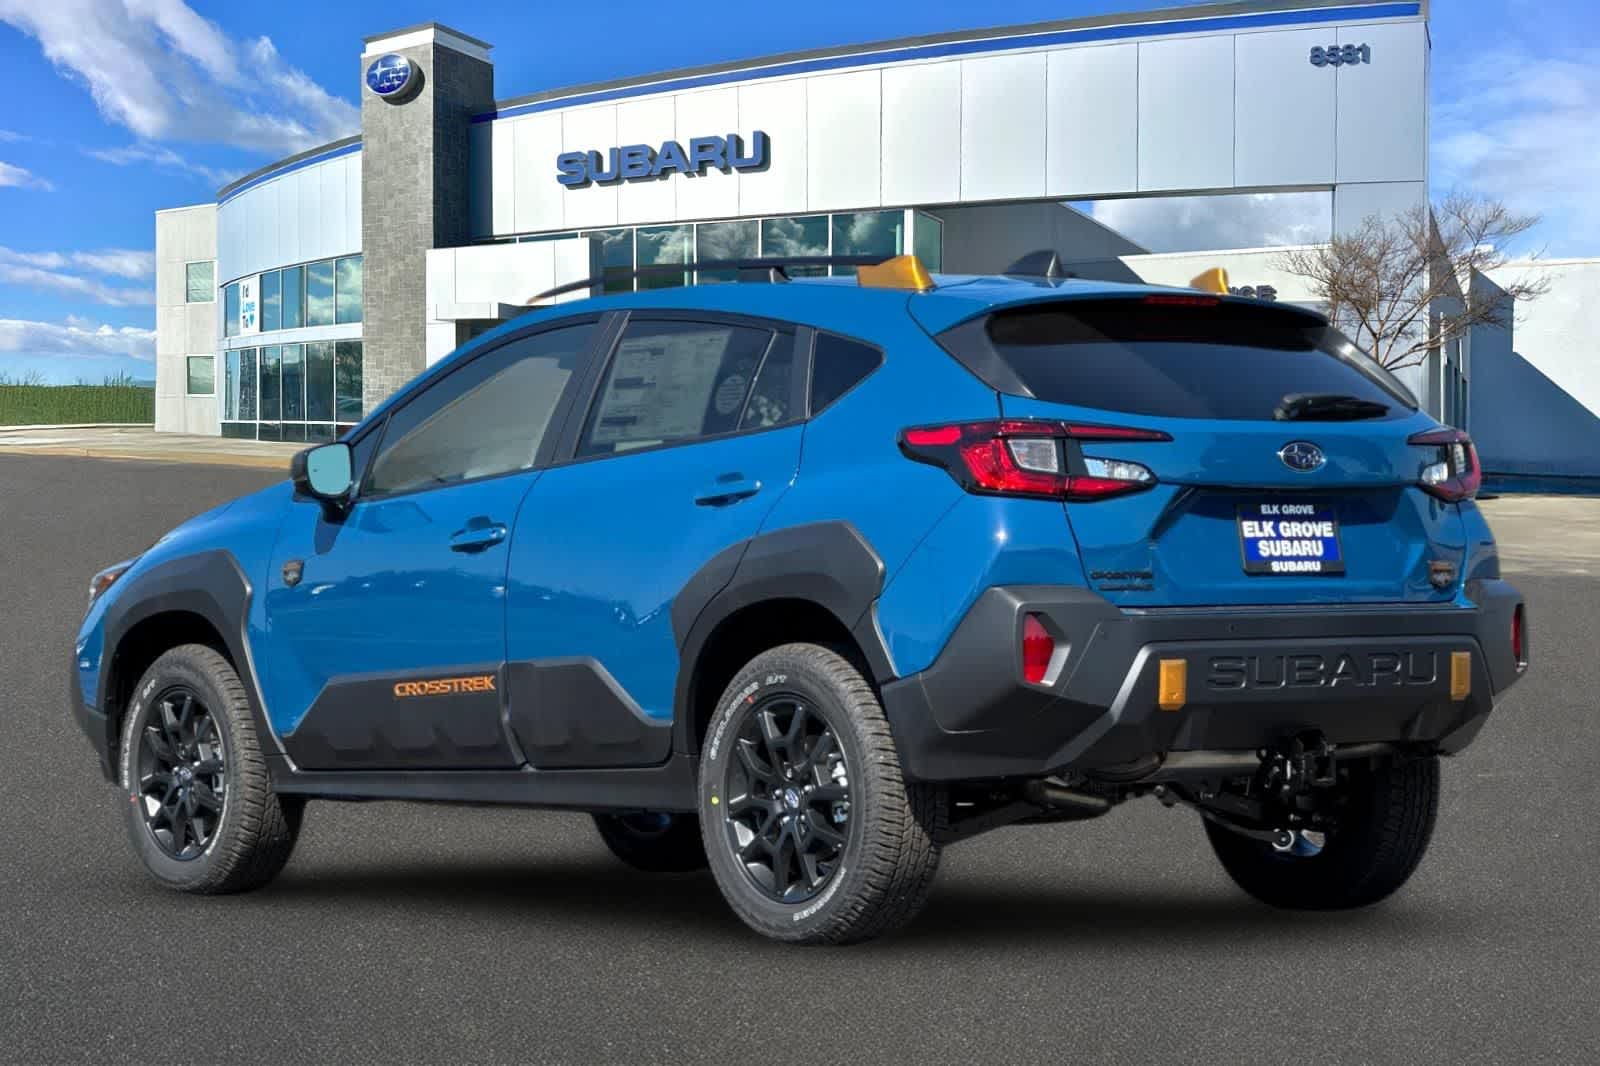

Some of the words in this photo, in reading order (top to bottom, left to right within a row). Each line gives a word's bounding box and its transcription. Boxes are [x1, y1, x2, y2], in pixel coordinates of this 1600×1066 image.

[556, 130, 771, 190] SUBARU
[1260, 504, 1280, 514] ELK
[1281, 504, 1315, 514] GROVE
[1242, 521, 1276, 538] ELK
[1279, 521, 1335, 538] GROVE
[1258, 540, 1324, 557] SUBARU
[1271, 561, 1321, 572] SUBARU
[1207, 652, 1438, 690] SUBARU
[393, 675, 496, 697] CROSSTREK
